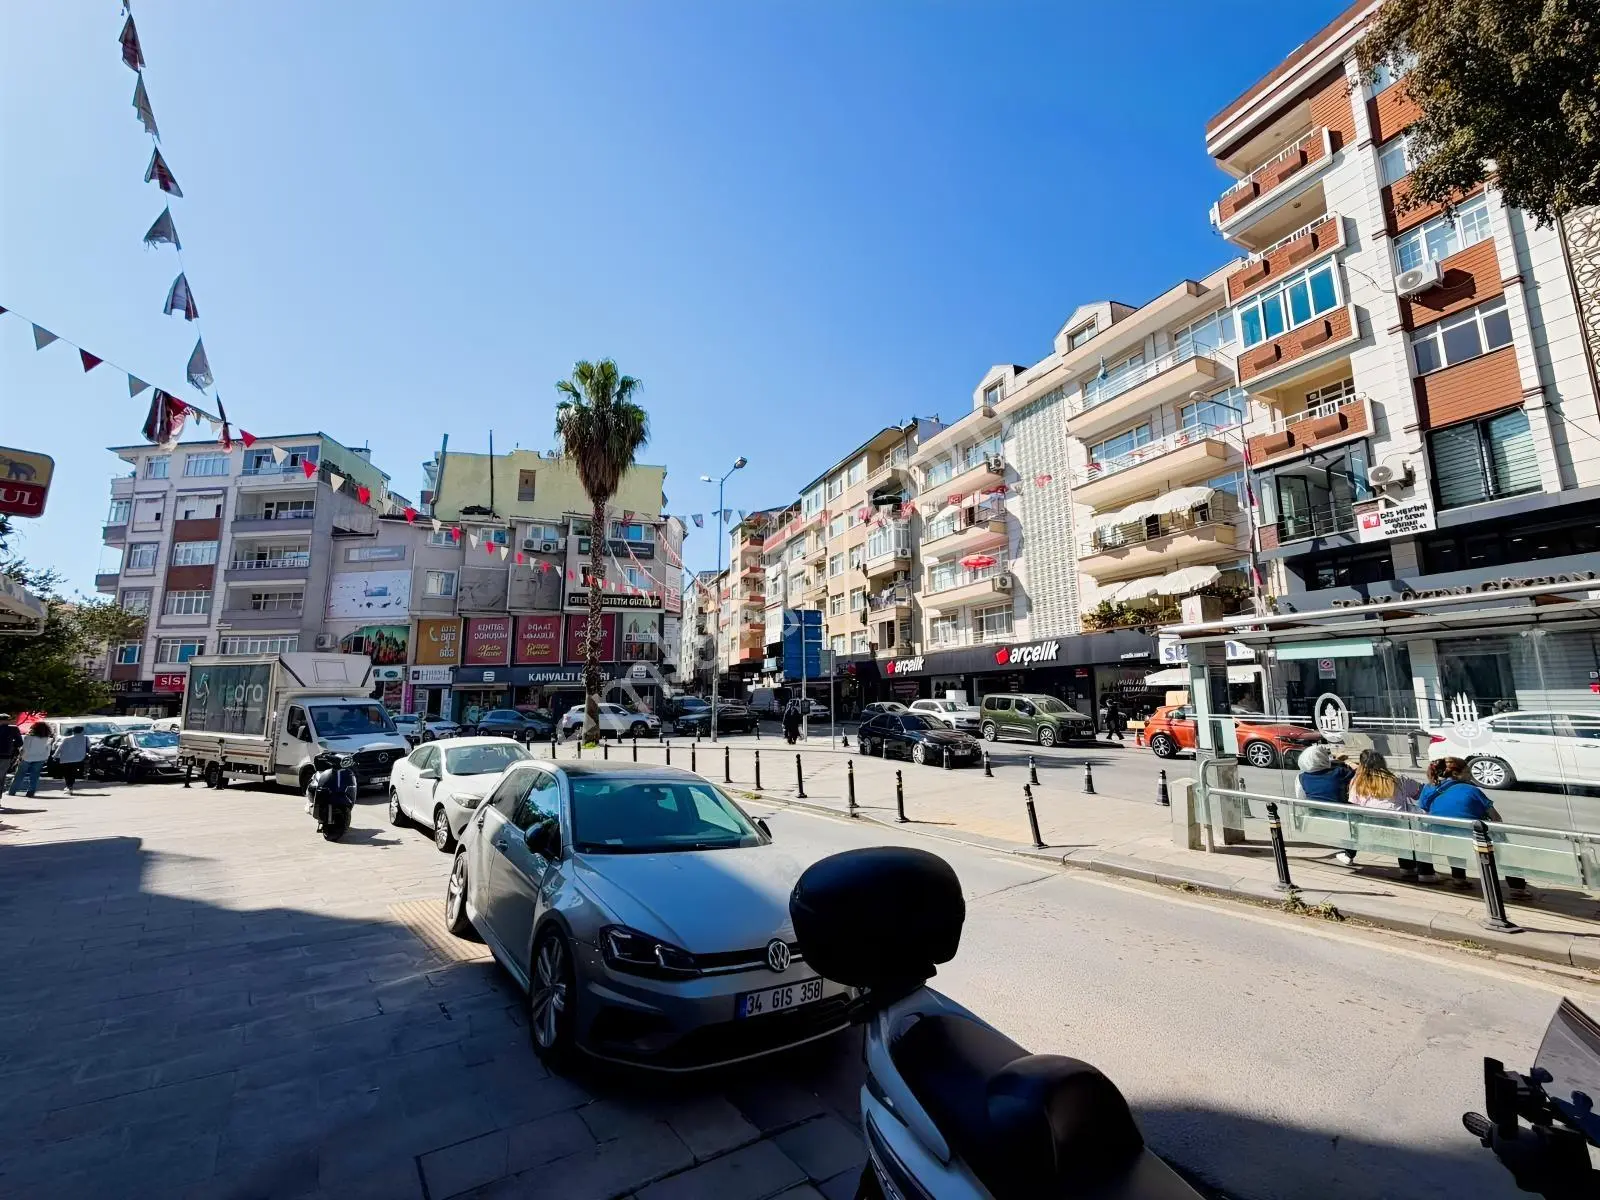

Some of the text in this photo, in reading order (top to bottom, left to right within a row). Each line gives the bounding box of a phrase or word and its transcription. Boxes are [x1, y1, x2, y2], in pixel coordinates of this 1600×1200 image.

[894, 656, 925, 675] arçelik
[1009, 641, 1060, 666] arçelik
[747, 981, 821, 1014] 34 GIS 358
